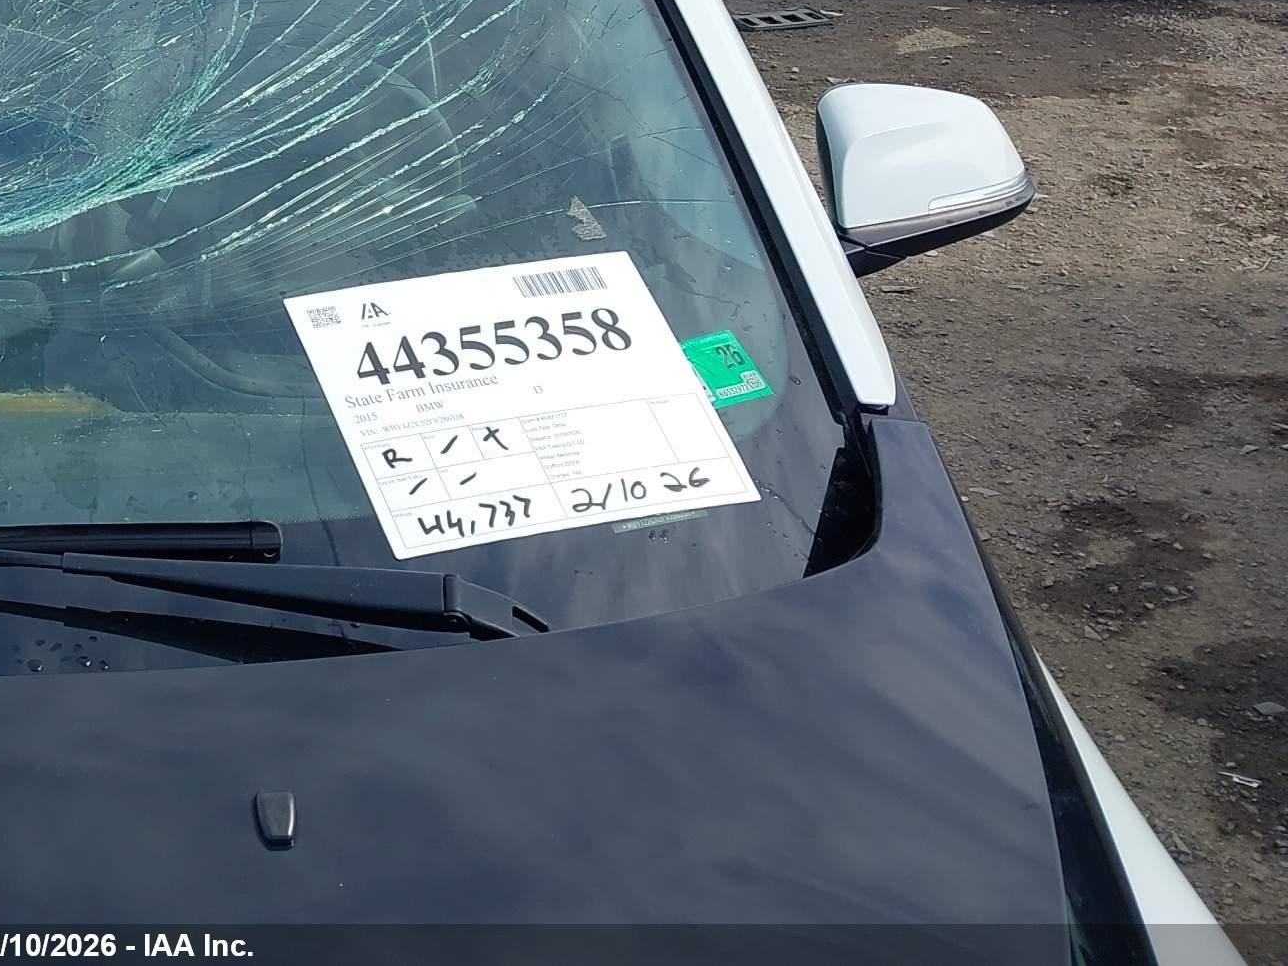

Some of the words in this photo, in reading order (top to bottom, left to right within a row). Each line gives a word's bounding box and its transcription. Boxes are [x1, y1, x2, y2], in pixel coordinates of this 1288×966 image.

[357, 308, 632, 385] 44355358
[344, 392, 383, 409] State
[386, 385, 426, 402] Farm
[428, 374, 499, 394] Insurance
[353, 411, 378, 424] 2015
[416, 401, 444, 414] BMW
